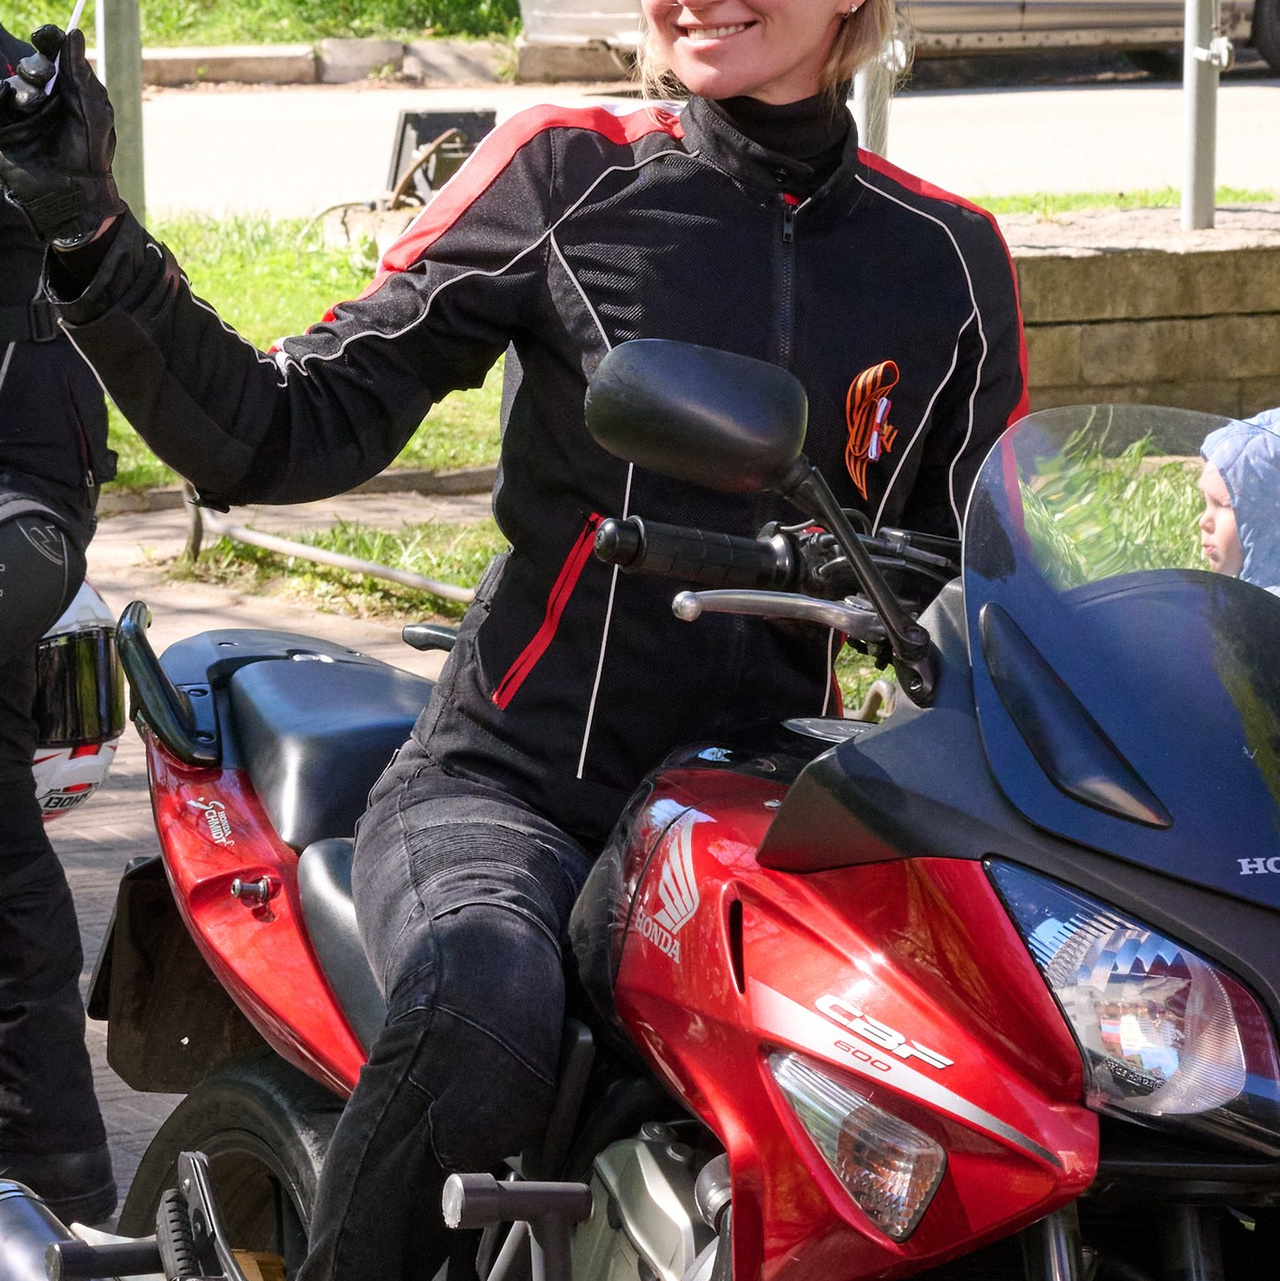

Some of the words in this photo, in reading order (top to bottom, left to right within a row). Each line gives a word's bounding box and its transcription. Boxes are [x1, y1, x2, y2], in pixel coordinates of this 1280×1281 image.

[218, 810, 232, 837] HONDA
[636, 909, 680, 964] HONDA
[814, 994, 955, 1070] CBF
[833, 1039, 893, 1072] 600
